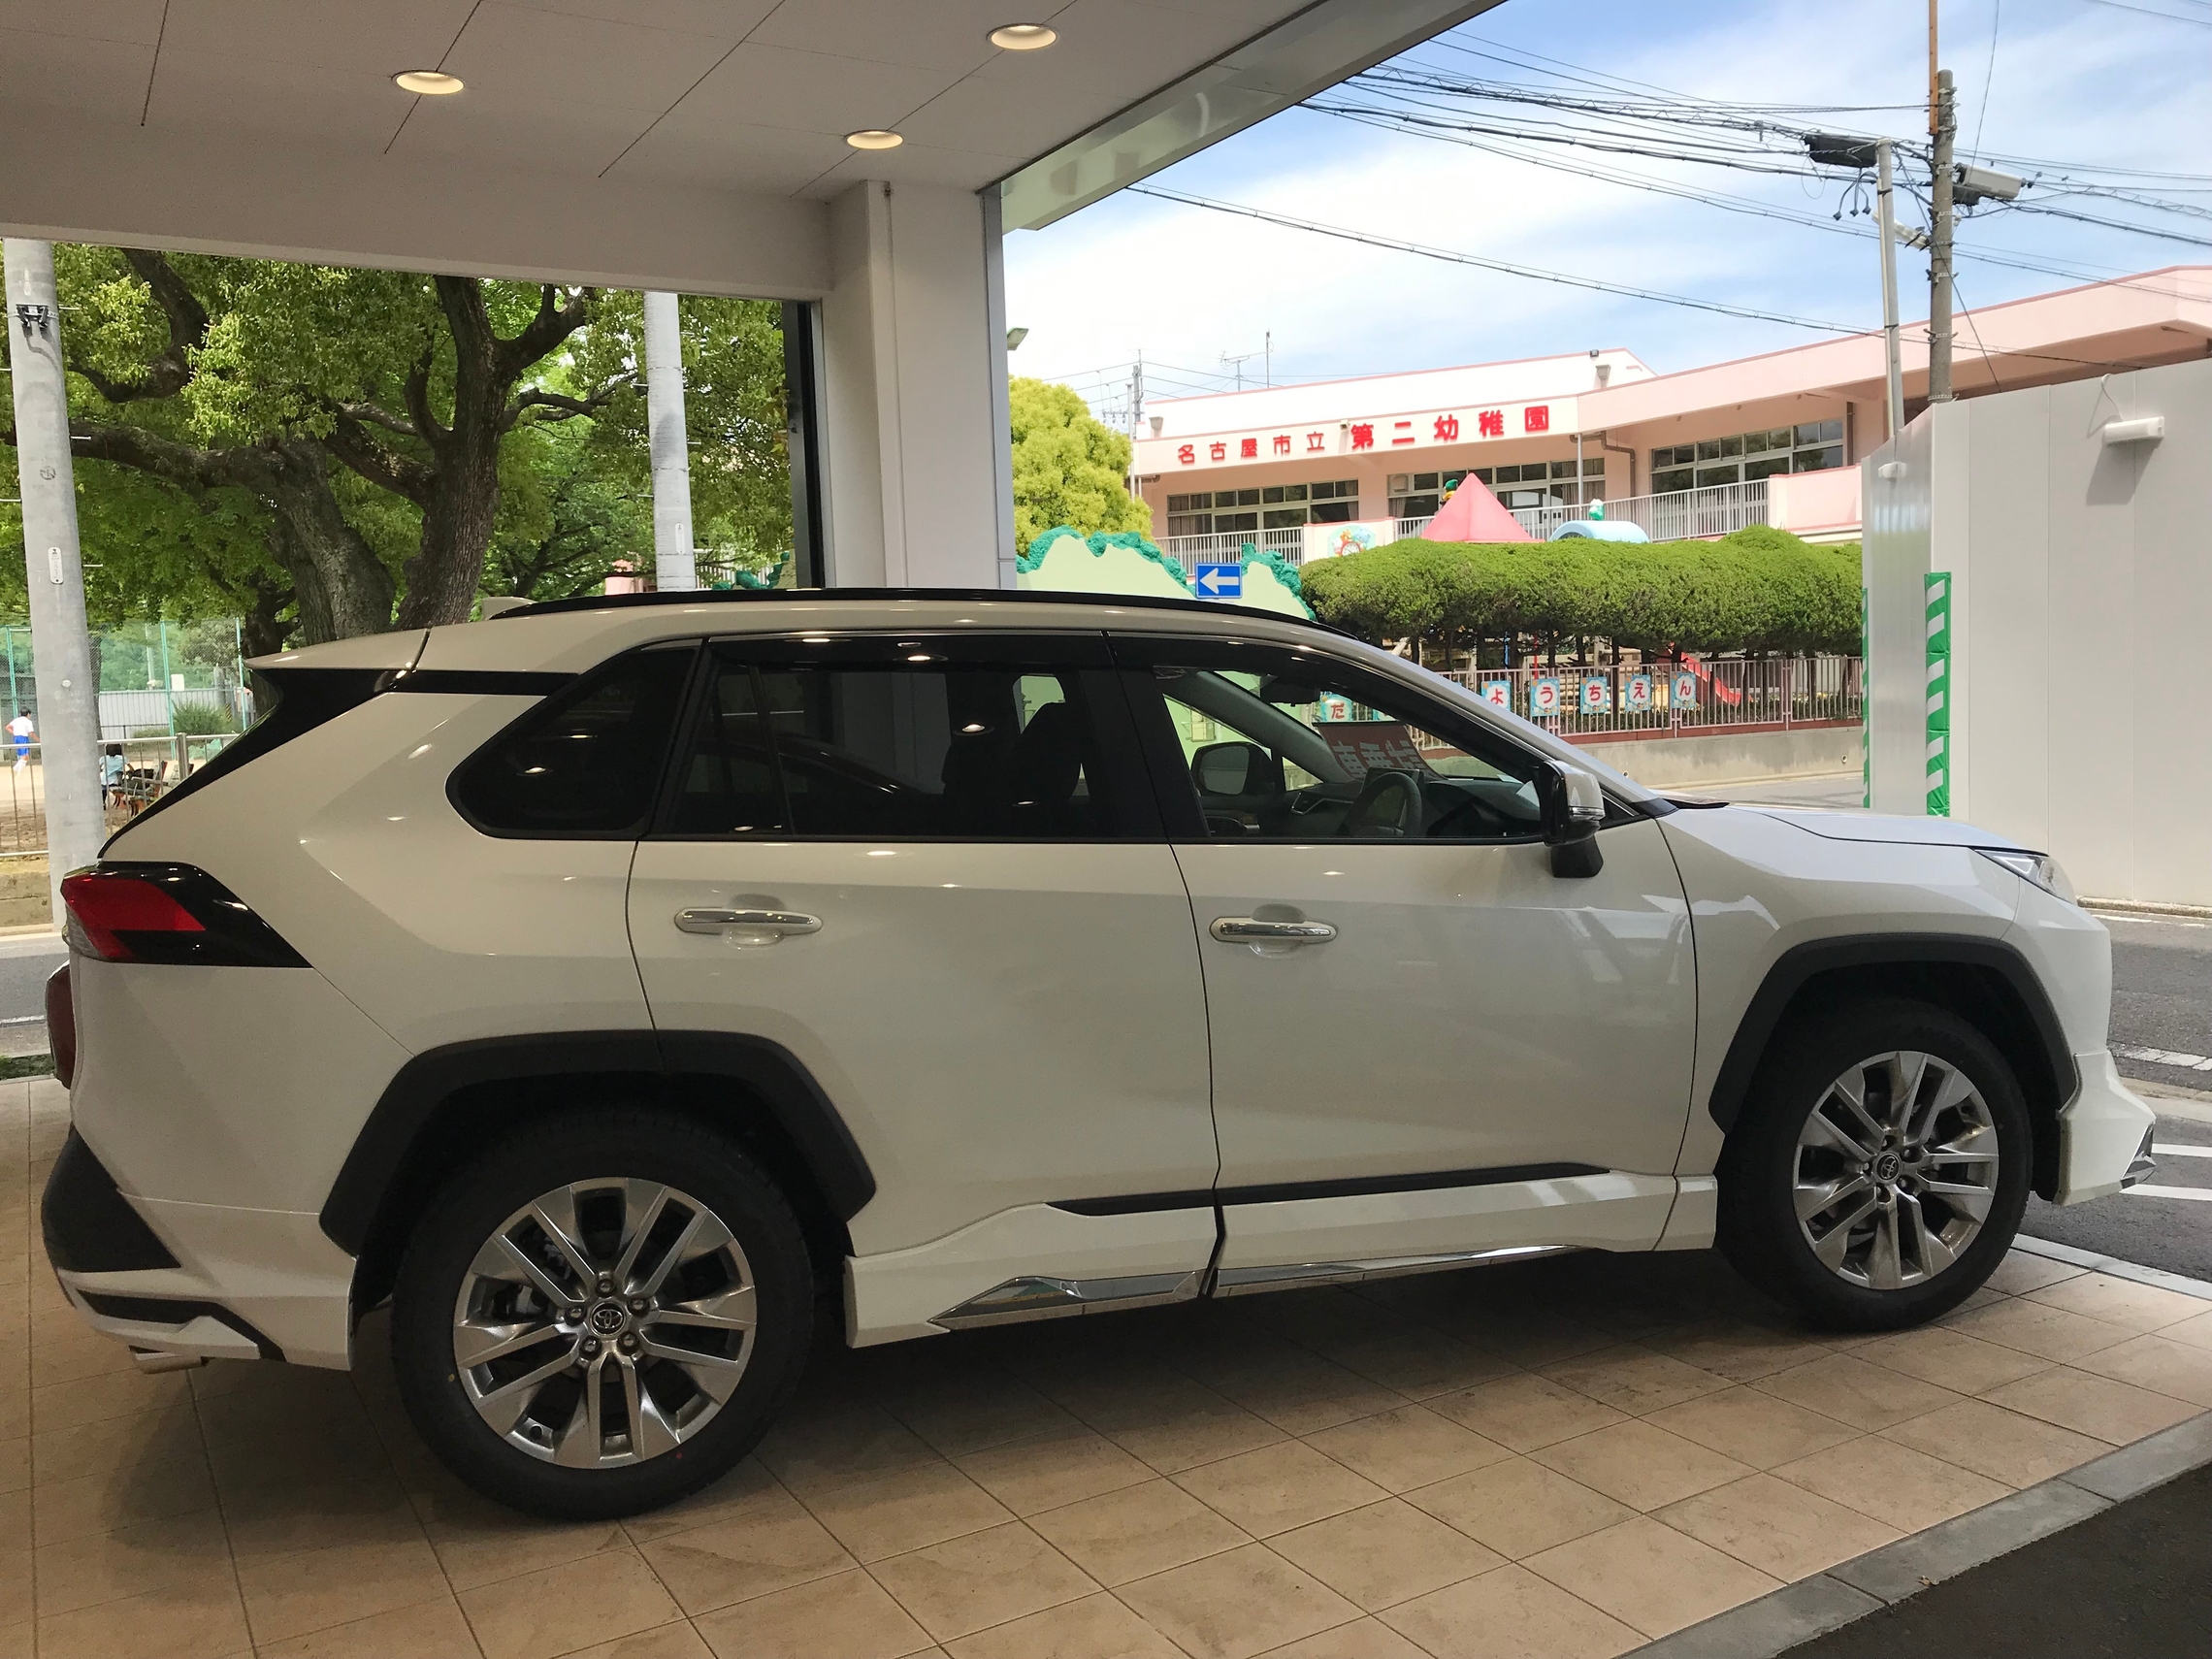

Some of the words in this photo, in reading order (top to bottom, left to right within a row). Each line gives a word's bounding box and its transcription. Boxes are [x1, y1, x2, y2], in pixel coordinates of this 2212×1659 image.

[1177, 431, 1325, 466] 名古屋市立
[1350, 405, 1549, 451] 第二幼稚園
